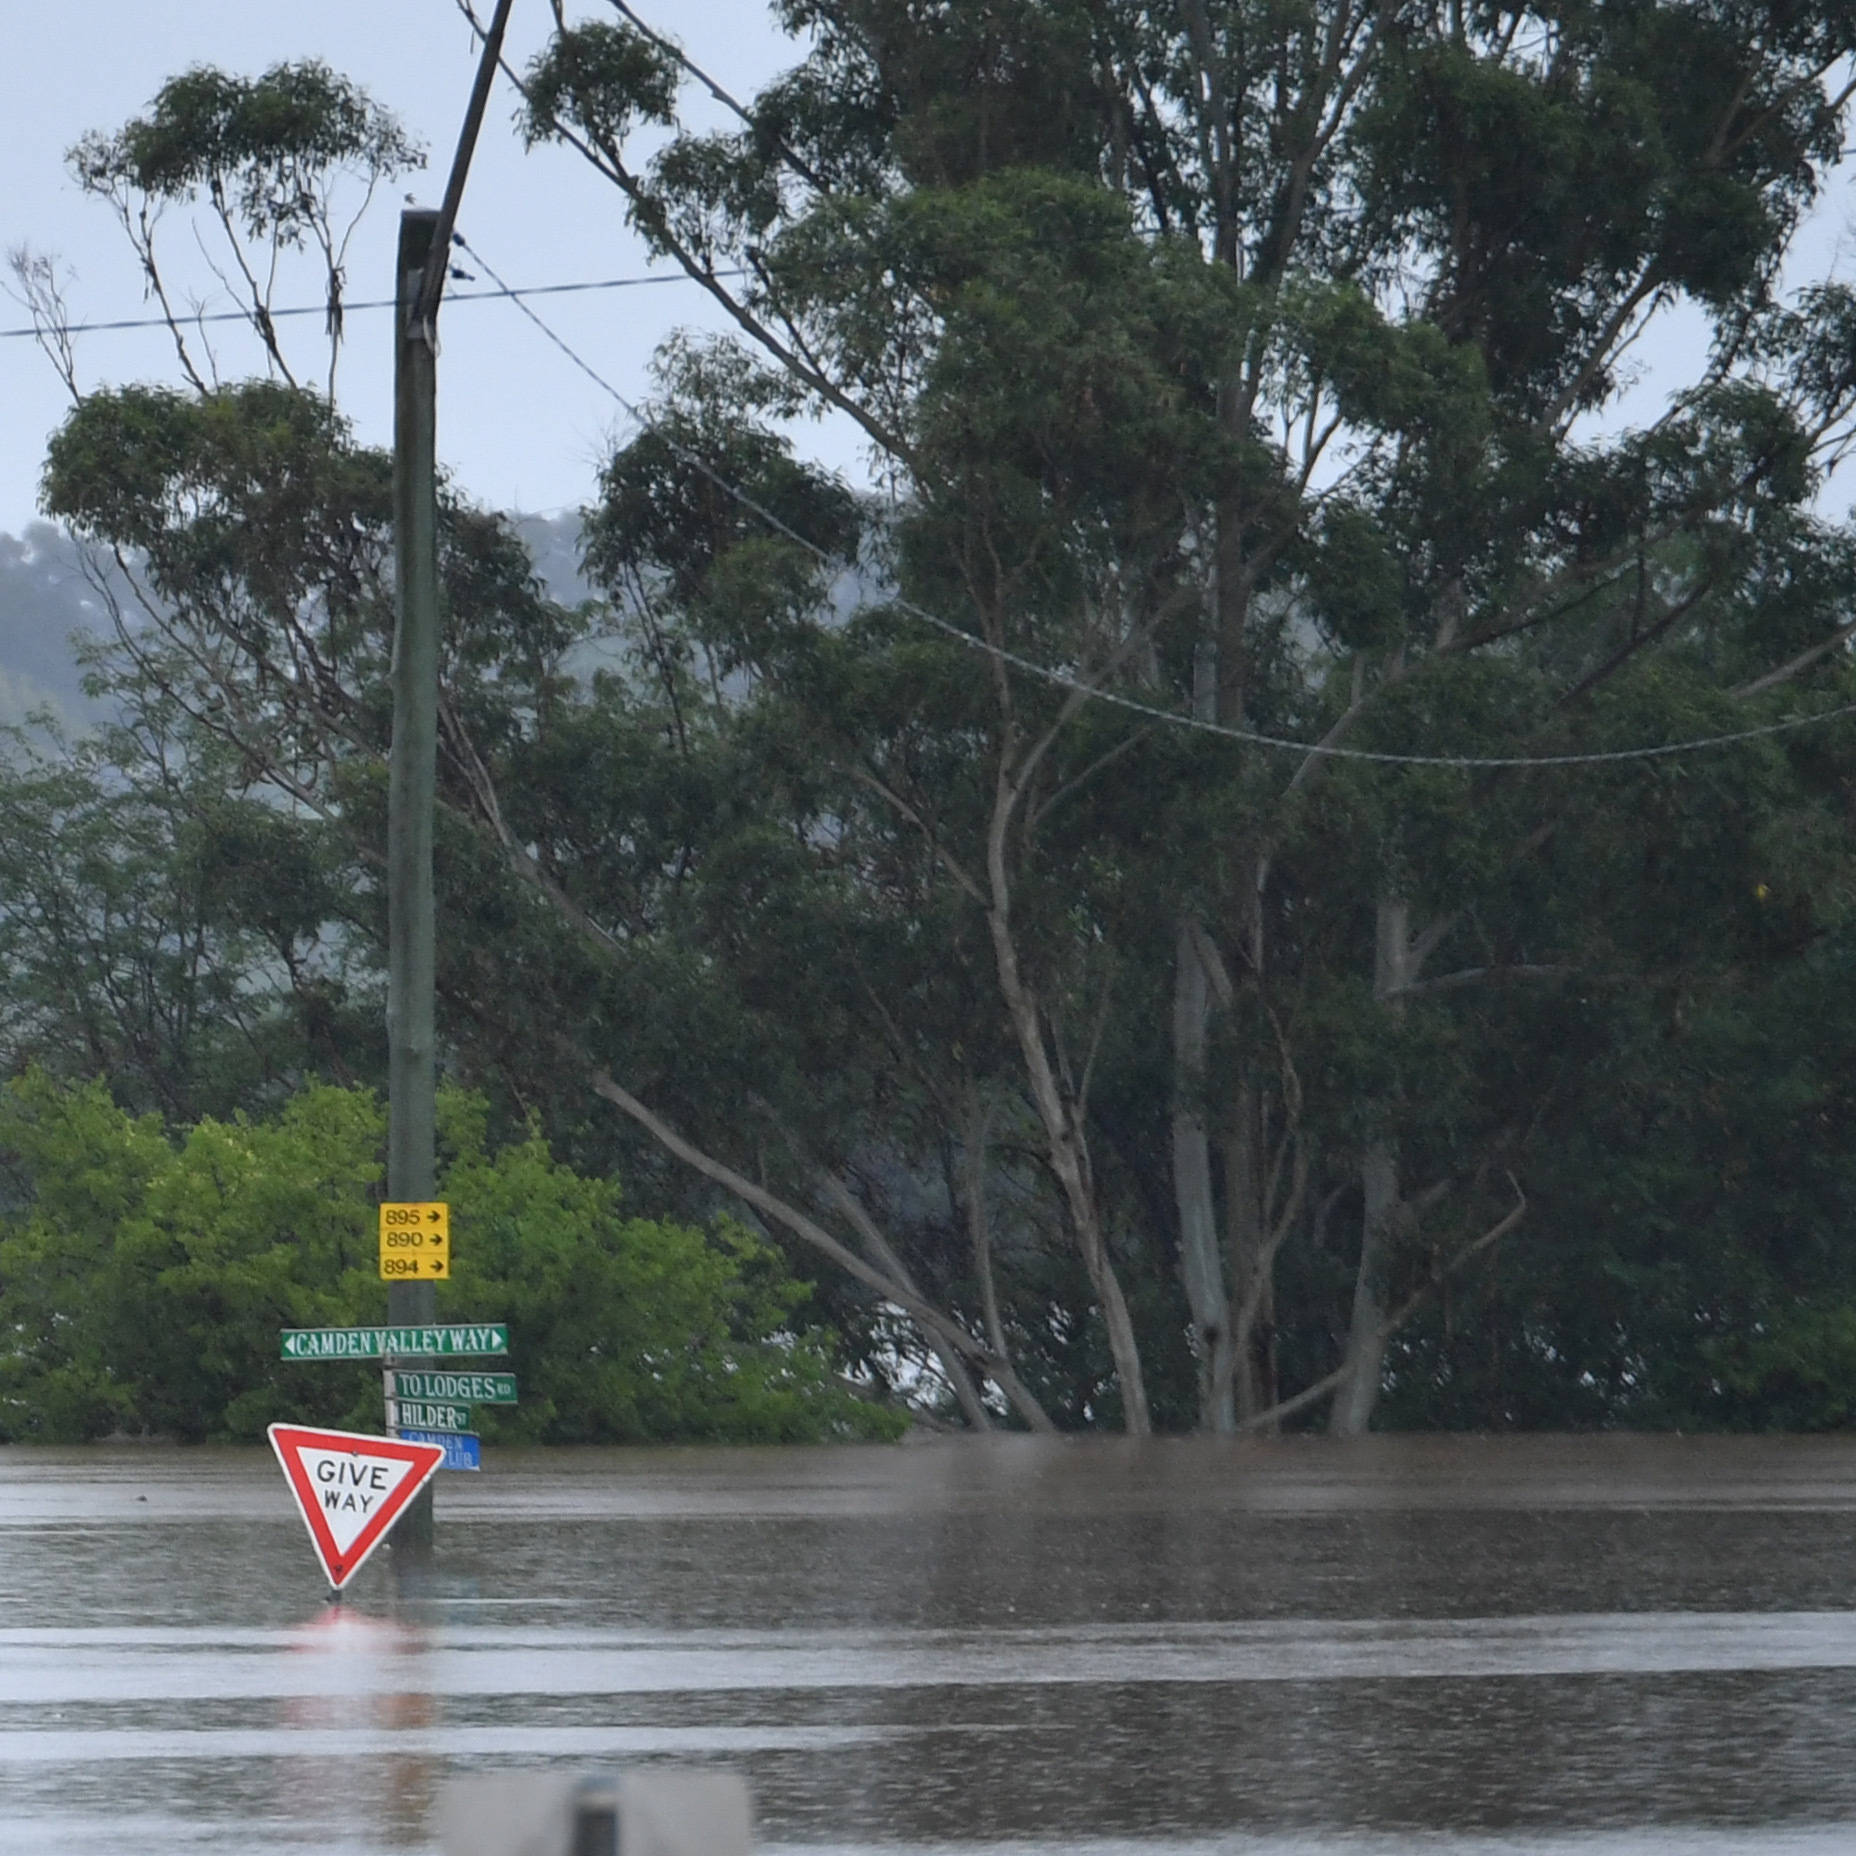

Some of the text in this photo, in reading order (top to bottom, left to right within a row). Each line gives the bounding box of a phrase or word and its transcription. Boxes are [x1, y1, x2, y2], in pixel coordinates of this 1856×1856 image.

[386, 1209, 420, 1225] 895
[387, 1232, 423, 1247] 890
[384, 1259, 419, 1274] 894
[296, 1328, 489, 1355] CAMDEN VALLEY WAY
[399, 1374, 511, 1399] TO LODGES RD
[402, 1403, 457, 1430] HILDER
[447, 1449, 473, 1468] LUB
[317, 1460, 389, 1490] GIVE
[325, 1490, 374, 1513] WAY
